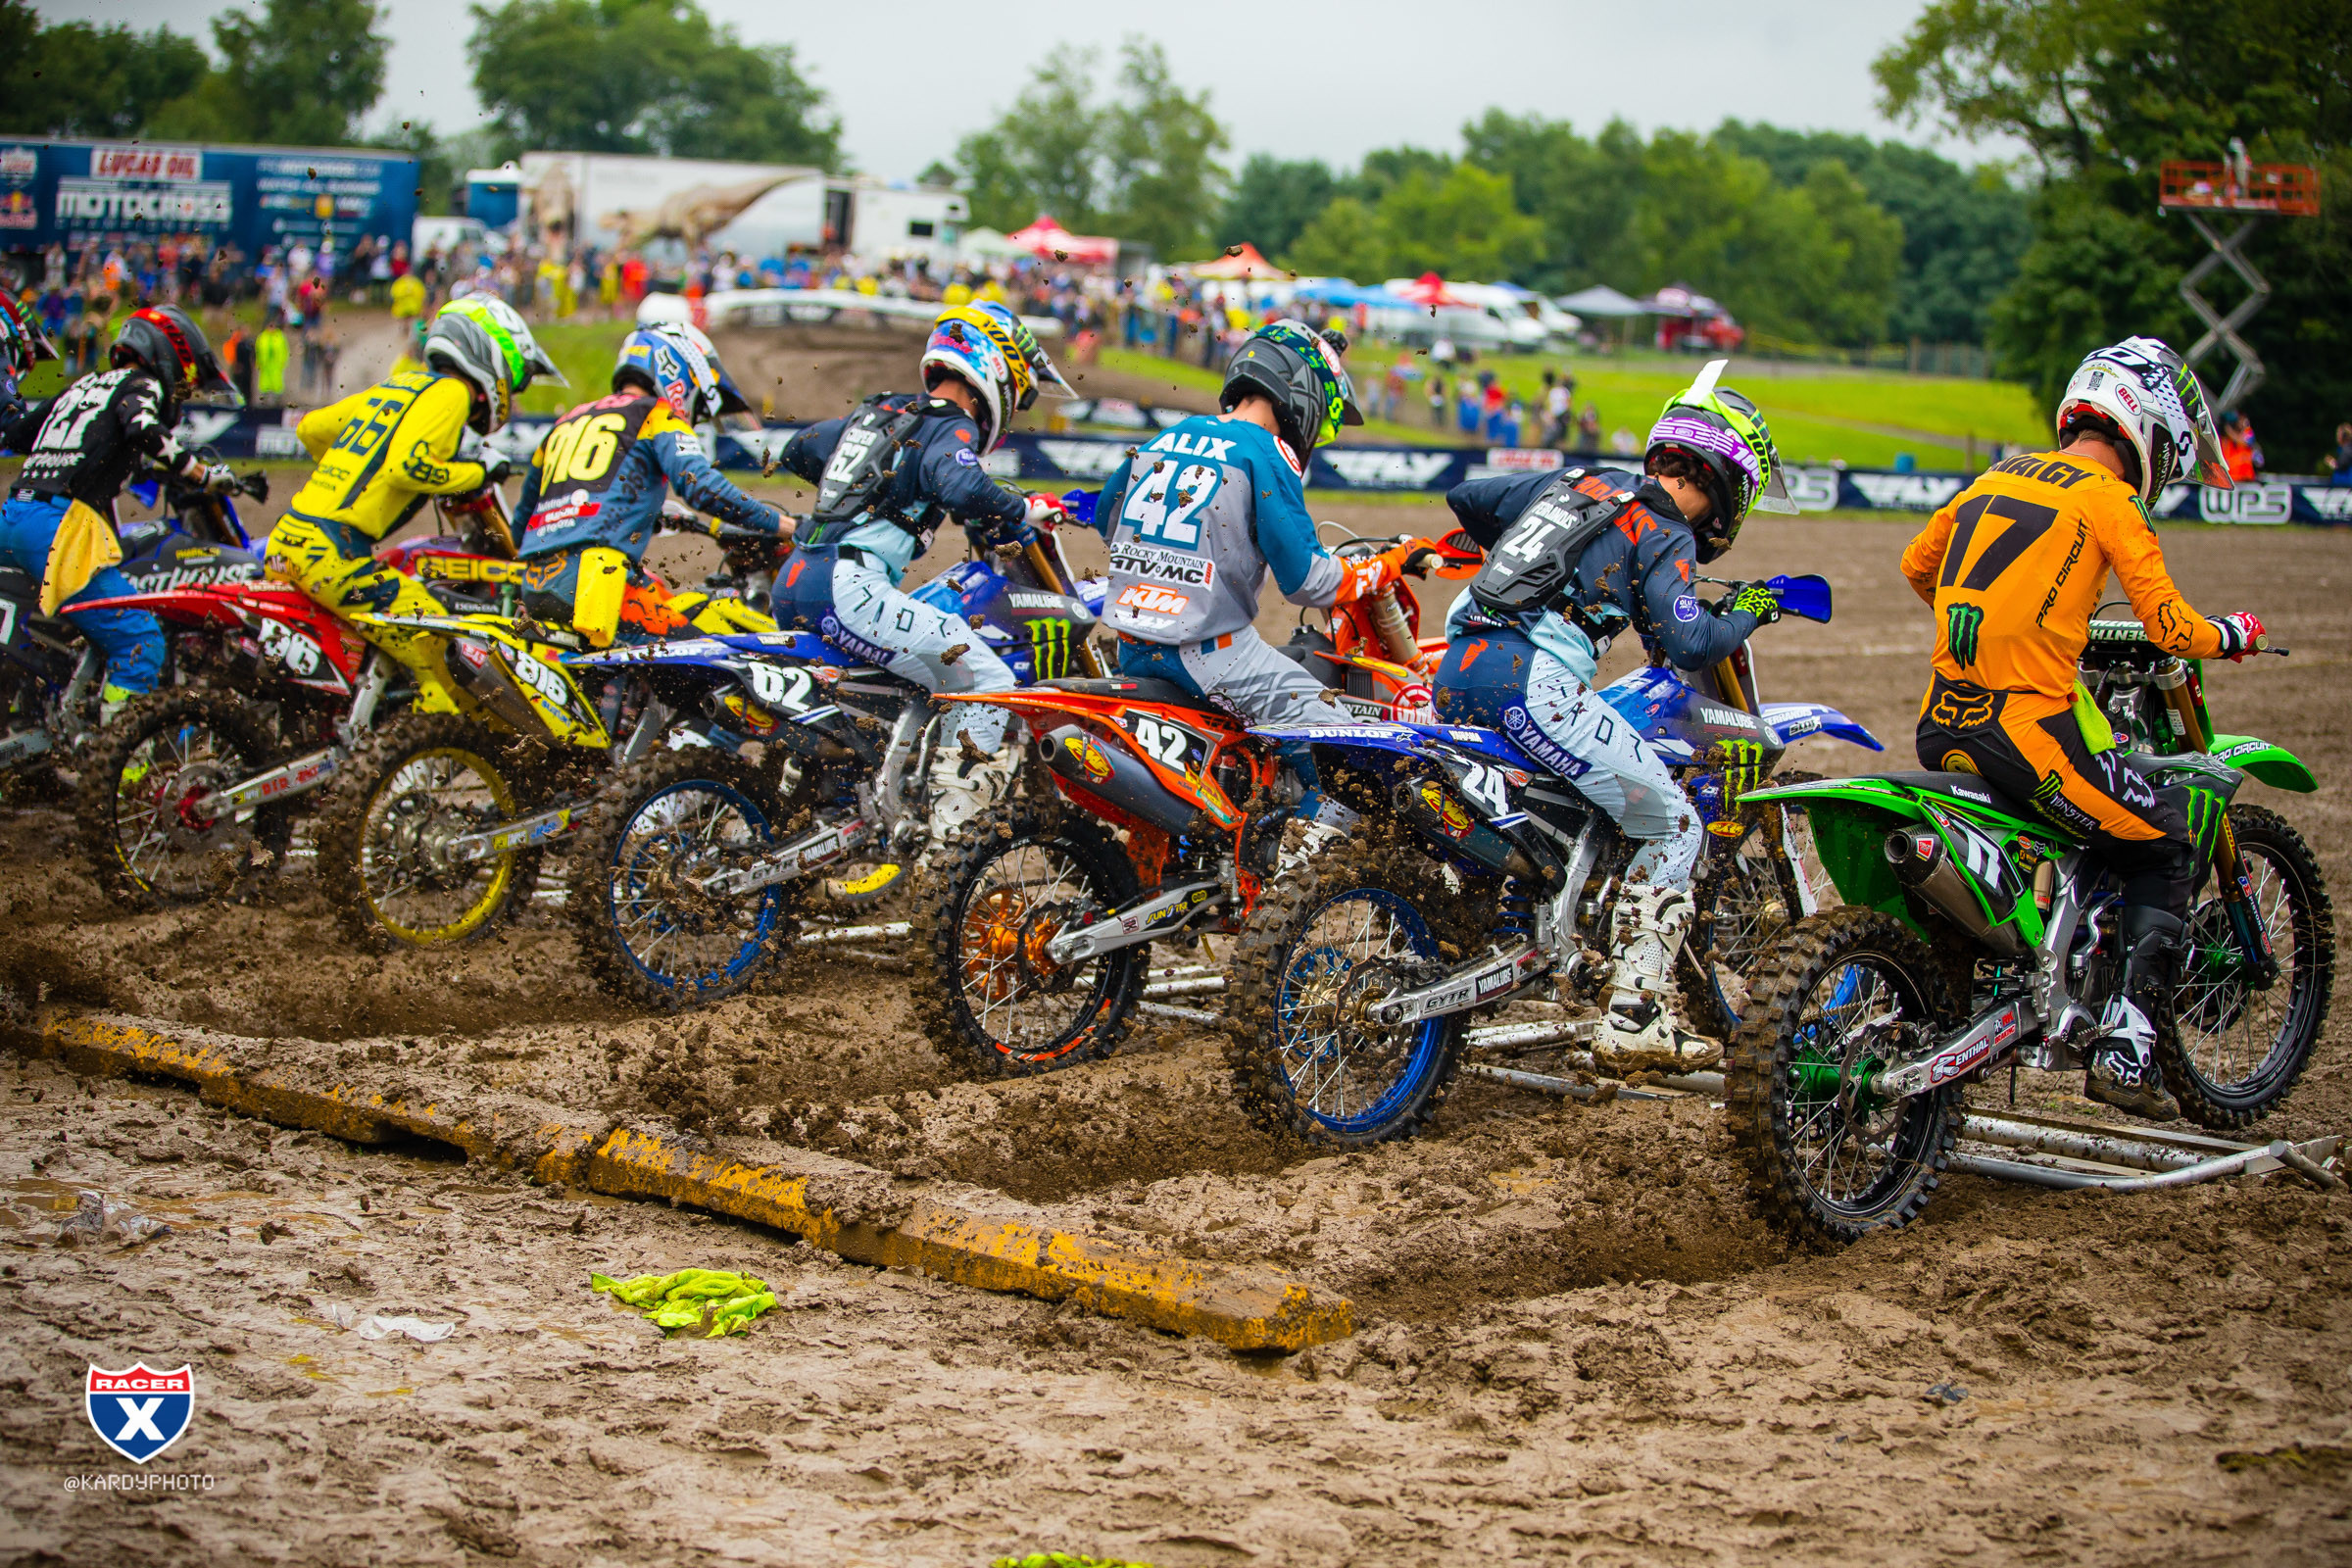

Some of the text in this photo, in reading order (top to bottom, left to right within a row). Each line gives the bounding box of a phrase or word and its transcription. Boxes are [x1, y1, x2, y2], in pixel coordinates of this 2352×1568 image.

[97, 153, 194, 179] LUCAS OIL
[56, 191, 231, 223] MOTOCROSS
[2118, 387, 2138, 413] BELL
[1149, 432, 1236, 462] ALIX
[1124, 460, 1218, 544] 42
[1501, 515, 1556, 564] 24
[1939, 494, 2060, 592] 17
[1121, 544, 1206, 568] ROCKY MOUNTAIN
[2034, 517, 2092, 629] PRO CIRCUIT
[454, 601, 500, 613] HONDA
[1008, 594, 1066, 609] YAMALUBE
[1118, 584, 1189, 614] KTM
[747, 662, 813, 713] 62
[541, 700, 571, 728] SUZUKI
[1699, 707, 1757, 730] YAMALUBE
[1136, 717, 1188, 773] 42
[1309, 729, 1394, 739] DUNLOP
[1518, 724, 1584, 779] YAMAHA
[2233, 739, 2272, 758] CIRCUIT
[1448, 754, 1510, 817] 24
[1950, 785, 1992, 804] Kawasaki
[1478, 967, 1513, 994] YAMALUBE
[1426, 989, 1469, 1009] GYTR
[2001, 1011, 2014, 1027] RK
